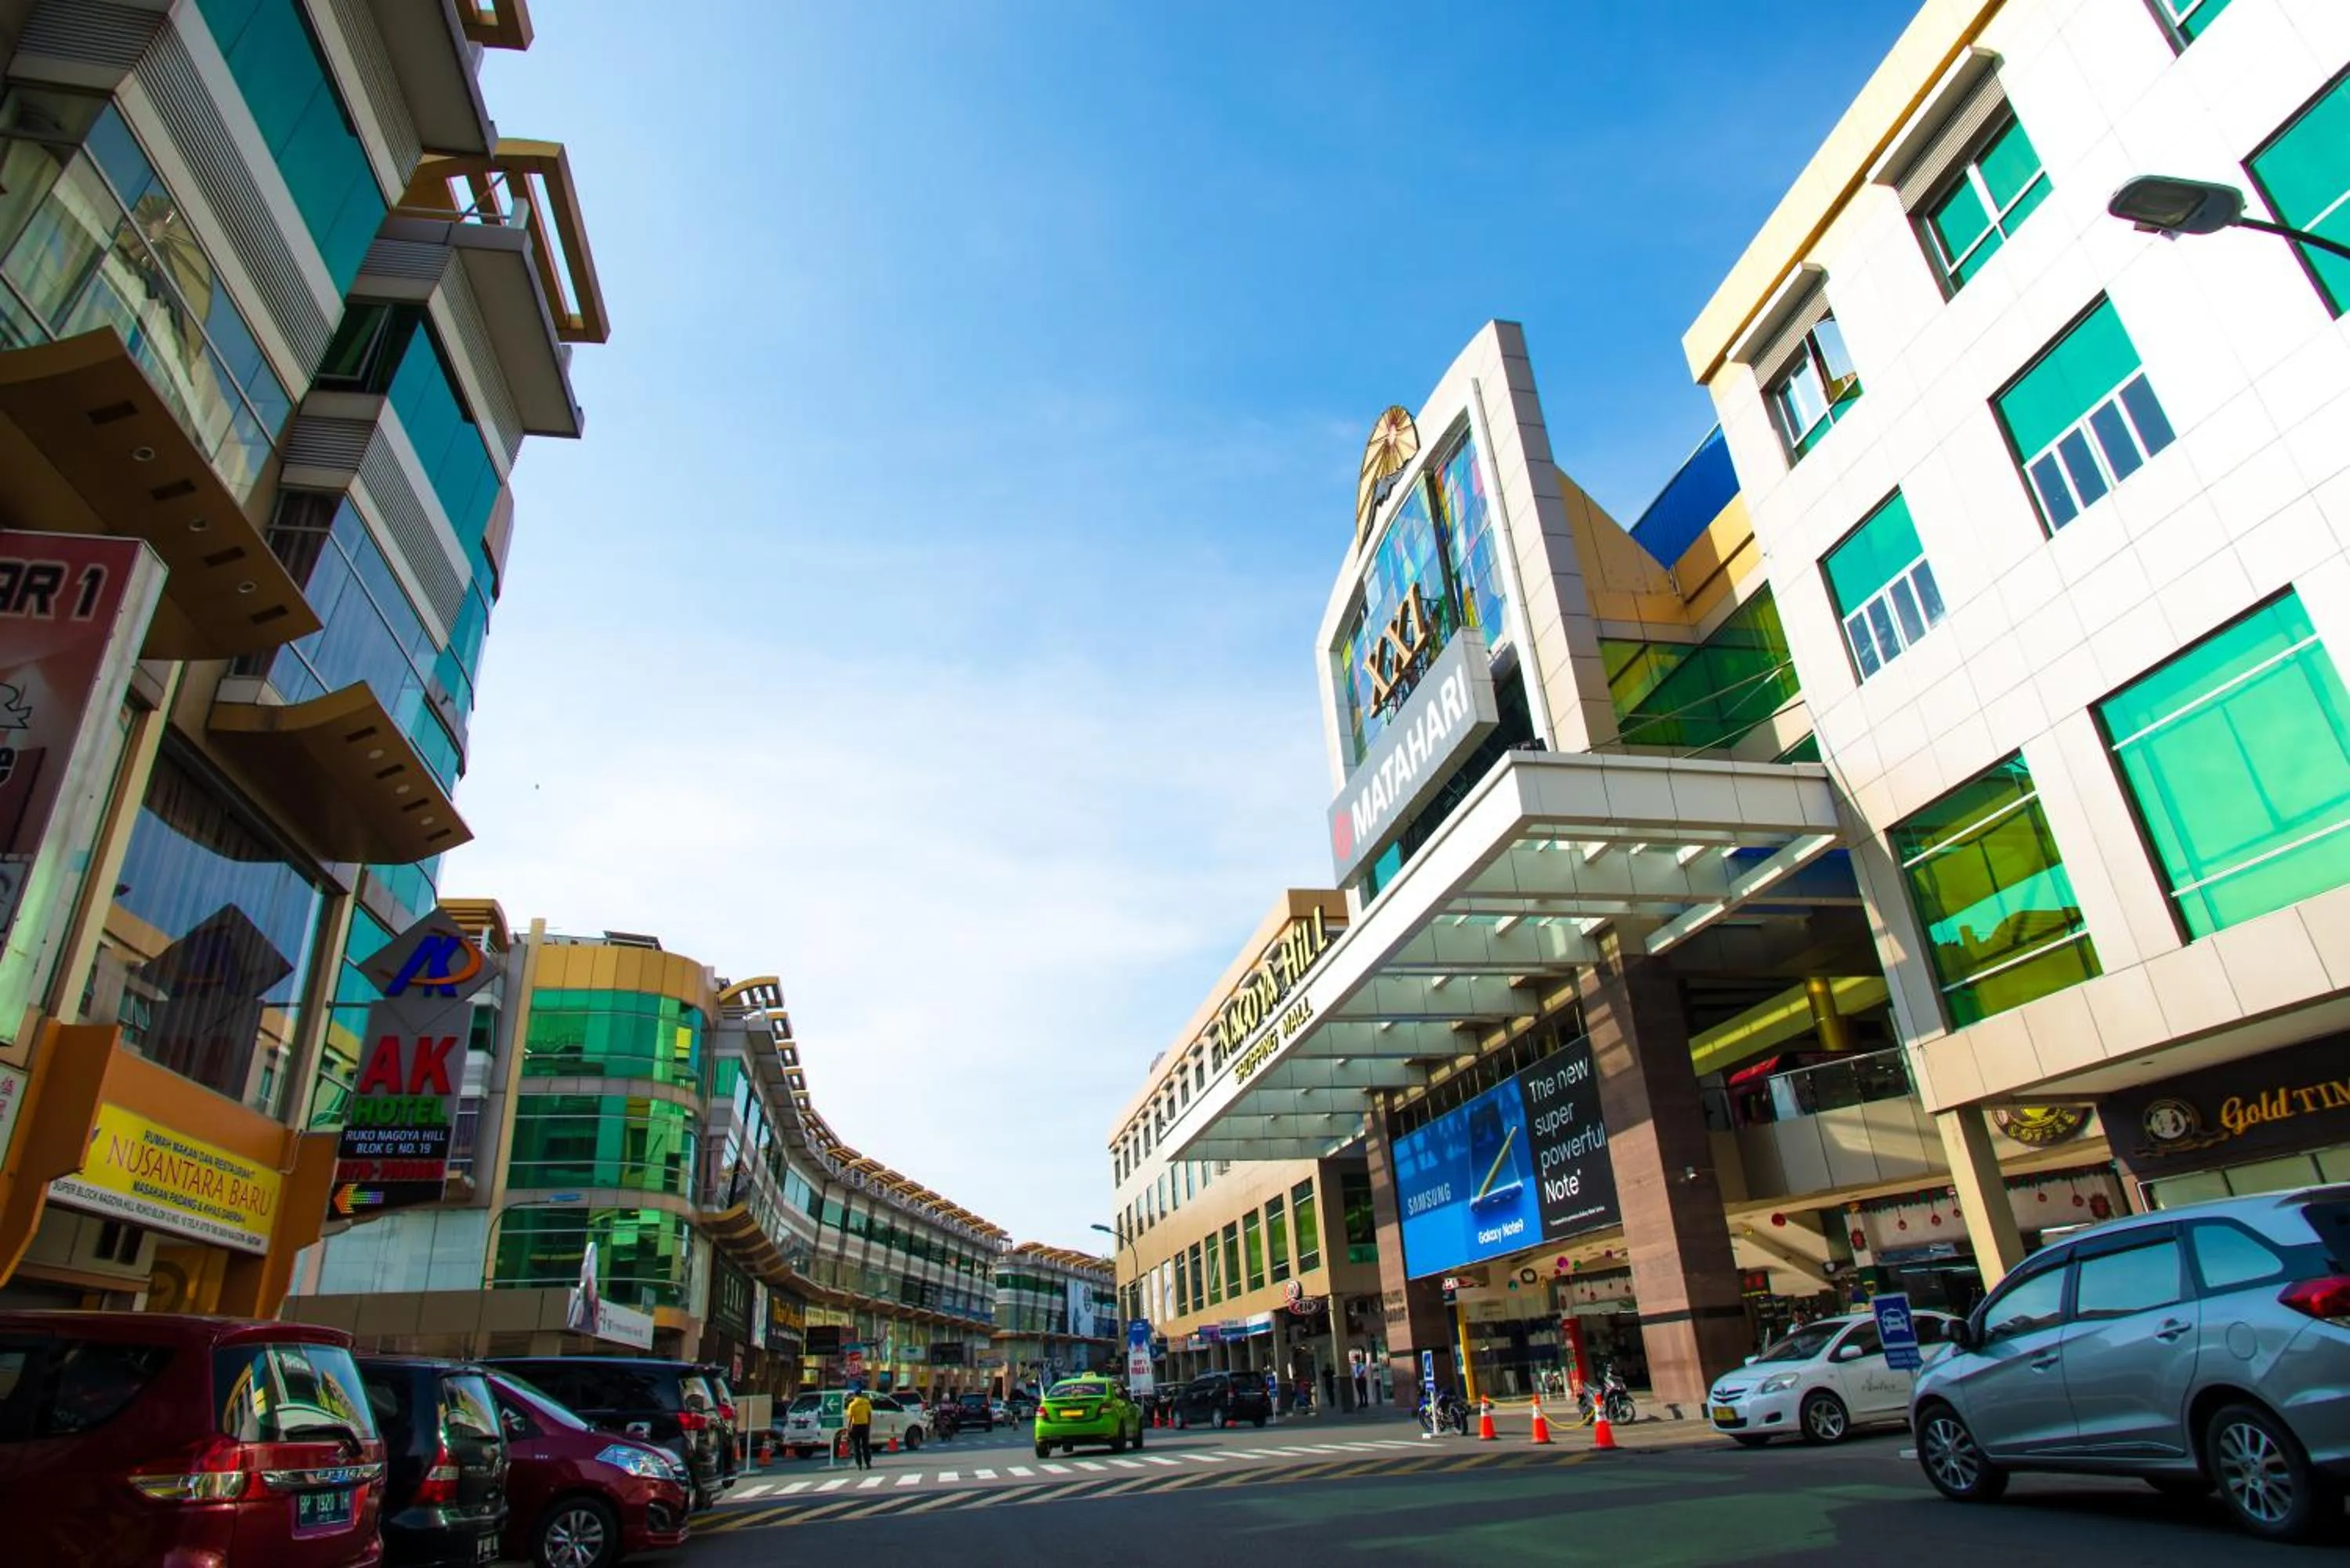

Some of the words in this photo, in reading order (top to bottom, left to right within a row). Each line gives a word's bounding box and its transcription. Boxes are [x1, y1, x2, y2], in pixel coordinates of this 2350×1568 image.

[73, 563, 108, 621] 1
[1364, 582, 1427, 719] XXI
[1351, 664, 1469, 844] MATAHARI
[1217, 959, 1282, 1055] NAGOYA
[359, 1035, 457, 1096] AK
[1235, 1029, 1279, 1085] SHOPPING
[1282, 996, 1314, 1039] MALL
[1528, 1078, 1555, 1104] The
[1556, 1057, 1589, 1091] new
[346, 1130, 375, 1142] RUKO
[377, 1129, 419, 1142] NAGOYA
[422, 1130, 445, 1142] HILL
[352, 1097, 449, 1126] HOTEL
[1535, 1101, 1574, 1136] super
[2221, 1086, 2296, 1135] Gold
[356, 1143, 384, 1154] BLOK
[419, 1143, 432, 1154] 19
[1540, 1122, 1608, 1176] powerful
[107, 1134, 224, 1202] NUSANTARA
[229, 1178, 272, 1216] BARU
[1408, 1183, 1452, 1216] SAMSUNG
[1478, 1226, 1502, 1245] Galaxy
[1502, 1218, 1524, 1238] Note9
